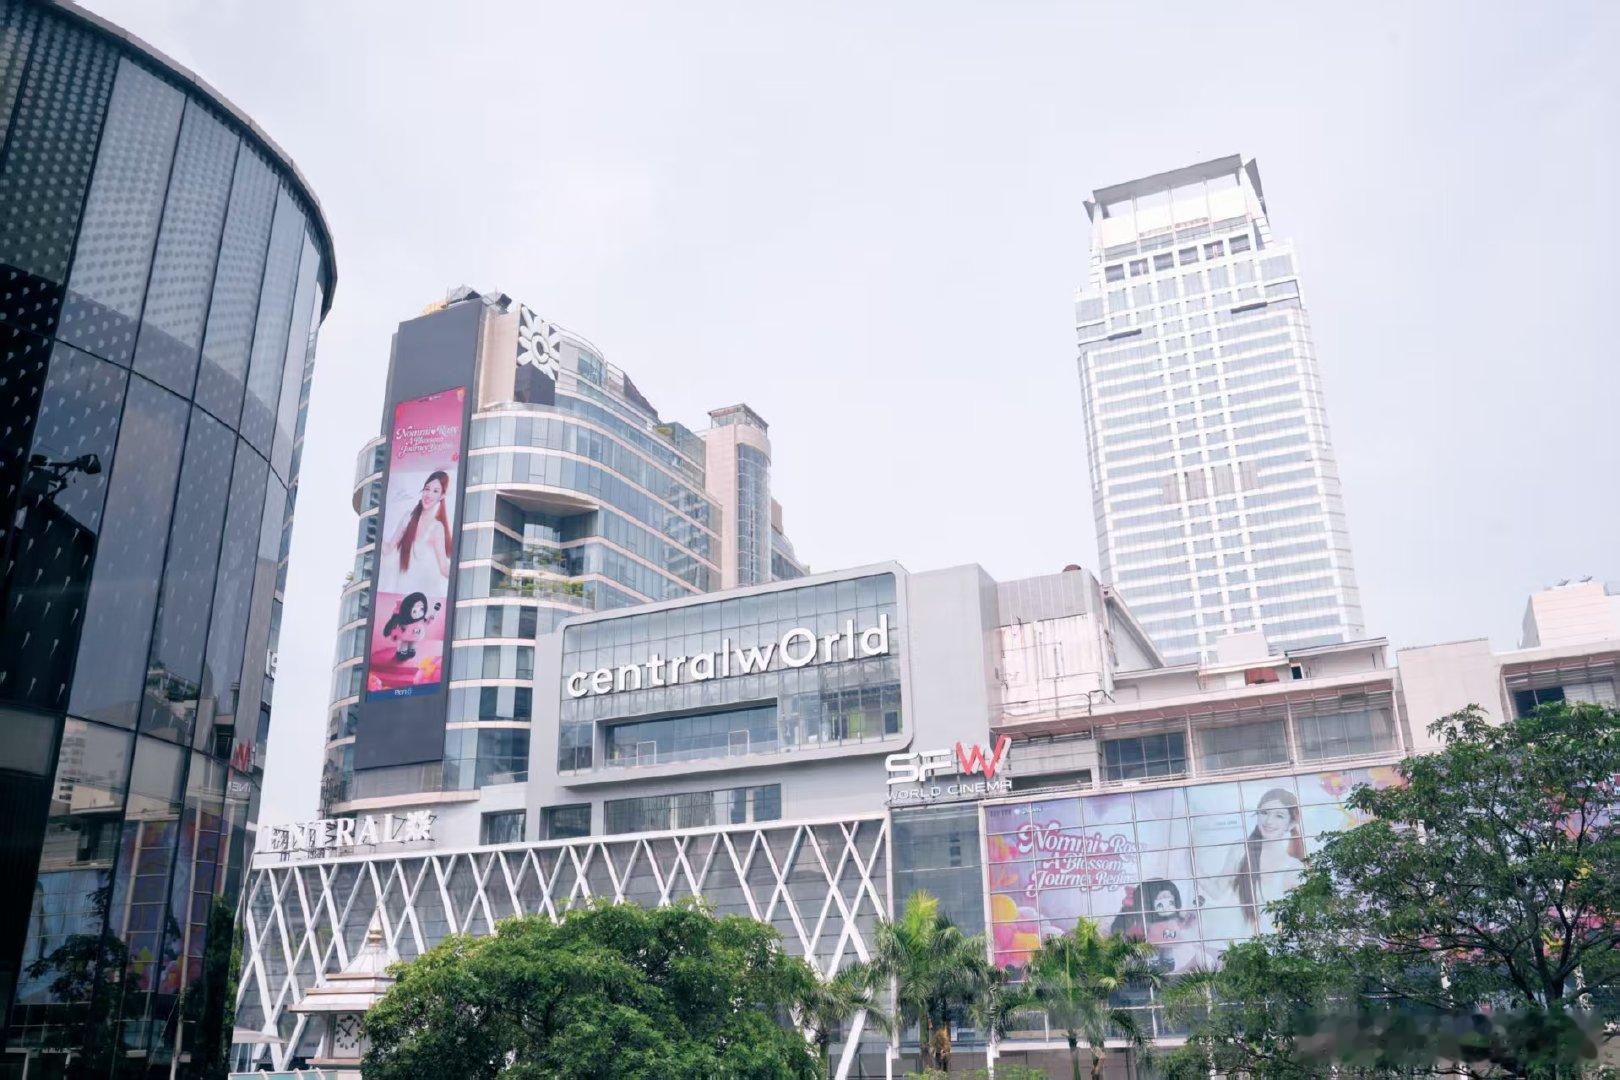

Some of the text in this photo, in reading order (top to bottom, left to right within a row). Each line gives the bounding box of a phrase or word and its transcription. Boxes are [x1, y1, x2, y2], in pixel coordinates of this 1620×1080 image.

[887, 780, 1013, 800] WORLD CINEMA
[1018, 821, 1101, 853] Nommi
